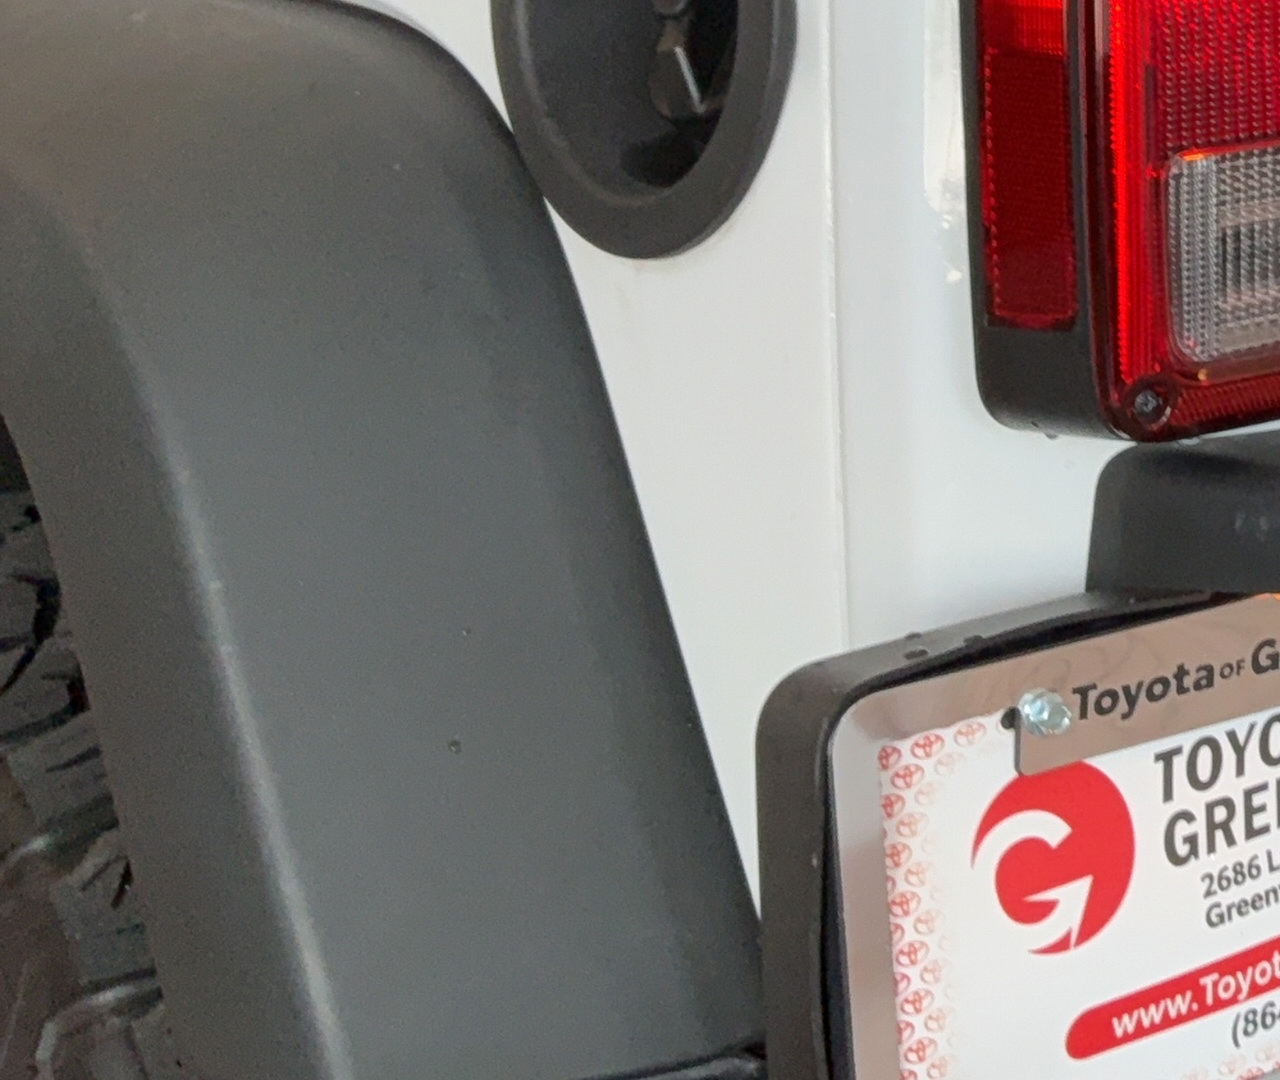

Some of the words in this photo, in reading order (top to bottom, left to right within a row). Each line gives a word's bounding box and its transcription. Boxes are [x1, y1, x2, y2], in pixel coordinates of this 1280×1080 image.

[1072, 661, 1216, 722] Toyota
[1219, 657, 1246, 681] OF
[1201, 854, 1262, 899] 2686
